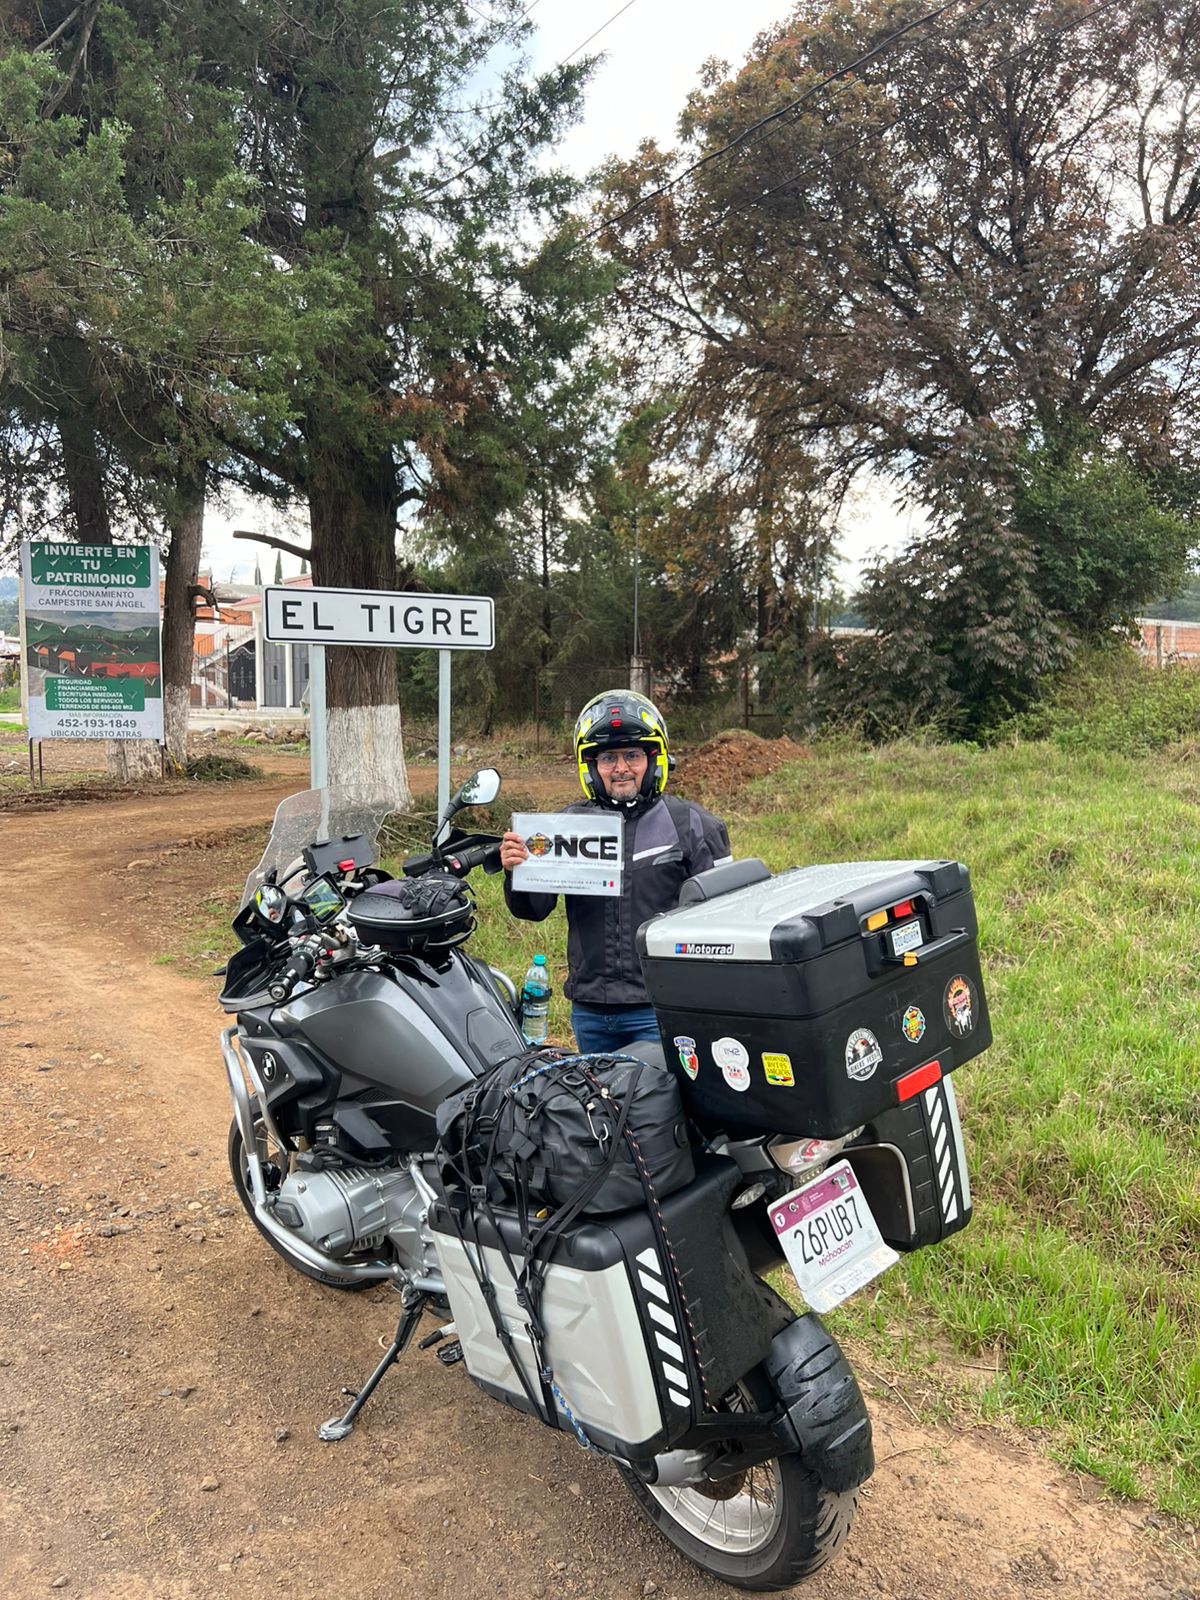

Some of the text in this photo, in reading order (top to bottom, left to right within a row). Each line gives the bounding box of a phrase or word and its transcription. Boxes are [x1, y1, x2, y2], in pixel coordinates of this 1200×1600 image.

[44, 545, 137, 558] INVIERTE EN
[81, 560, 101, 571] TU
[46, 572, 137, 585] PATRIMONIO
[49, 589, 135, 599] FRACCIONAMIENTO
[38, 598, 93, 607] CAMPESTRE
[95, 599, 114, 608] SAN
[282, 600, 479, 637] EL TIGRE
[57, 719, 137, 728] 452-193-1849
[89, 730, 115, 738] JUSTO
[686, 943, 734, 954] Motorrad
[793, 1195, 864, 1265] 26PUB7
[818, 1239, 854, 1269] Michoacán
